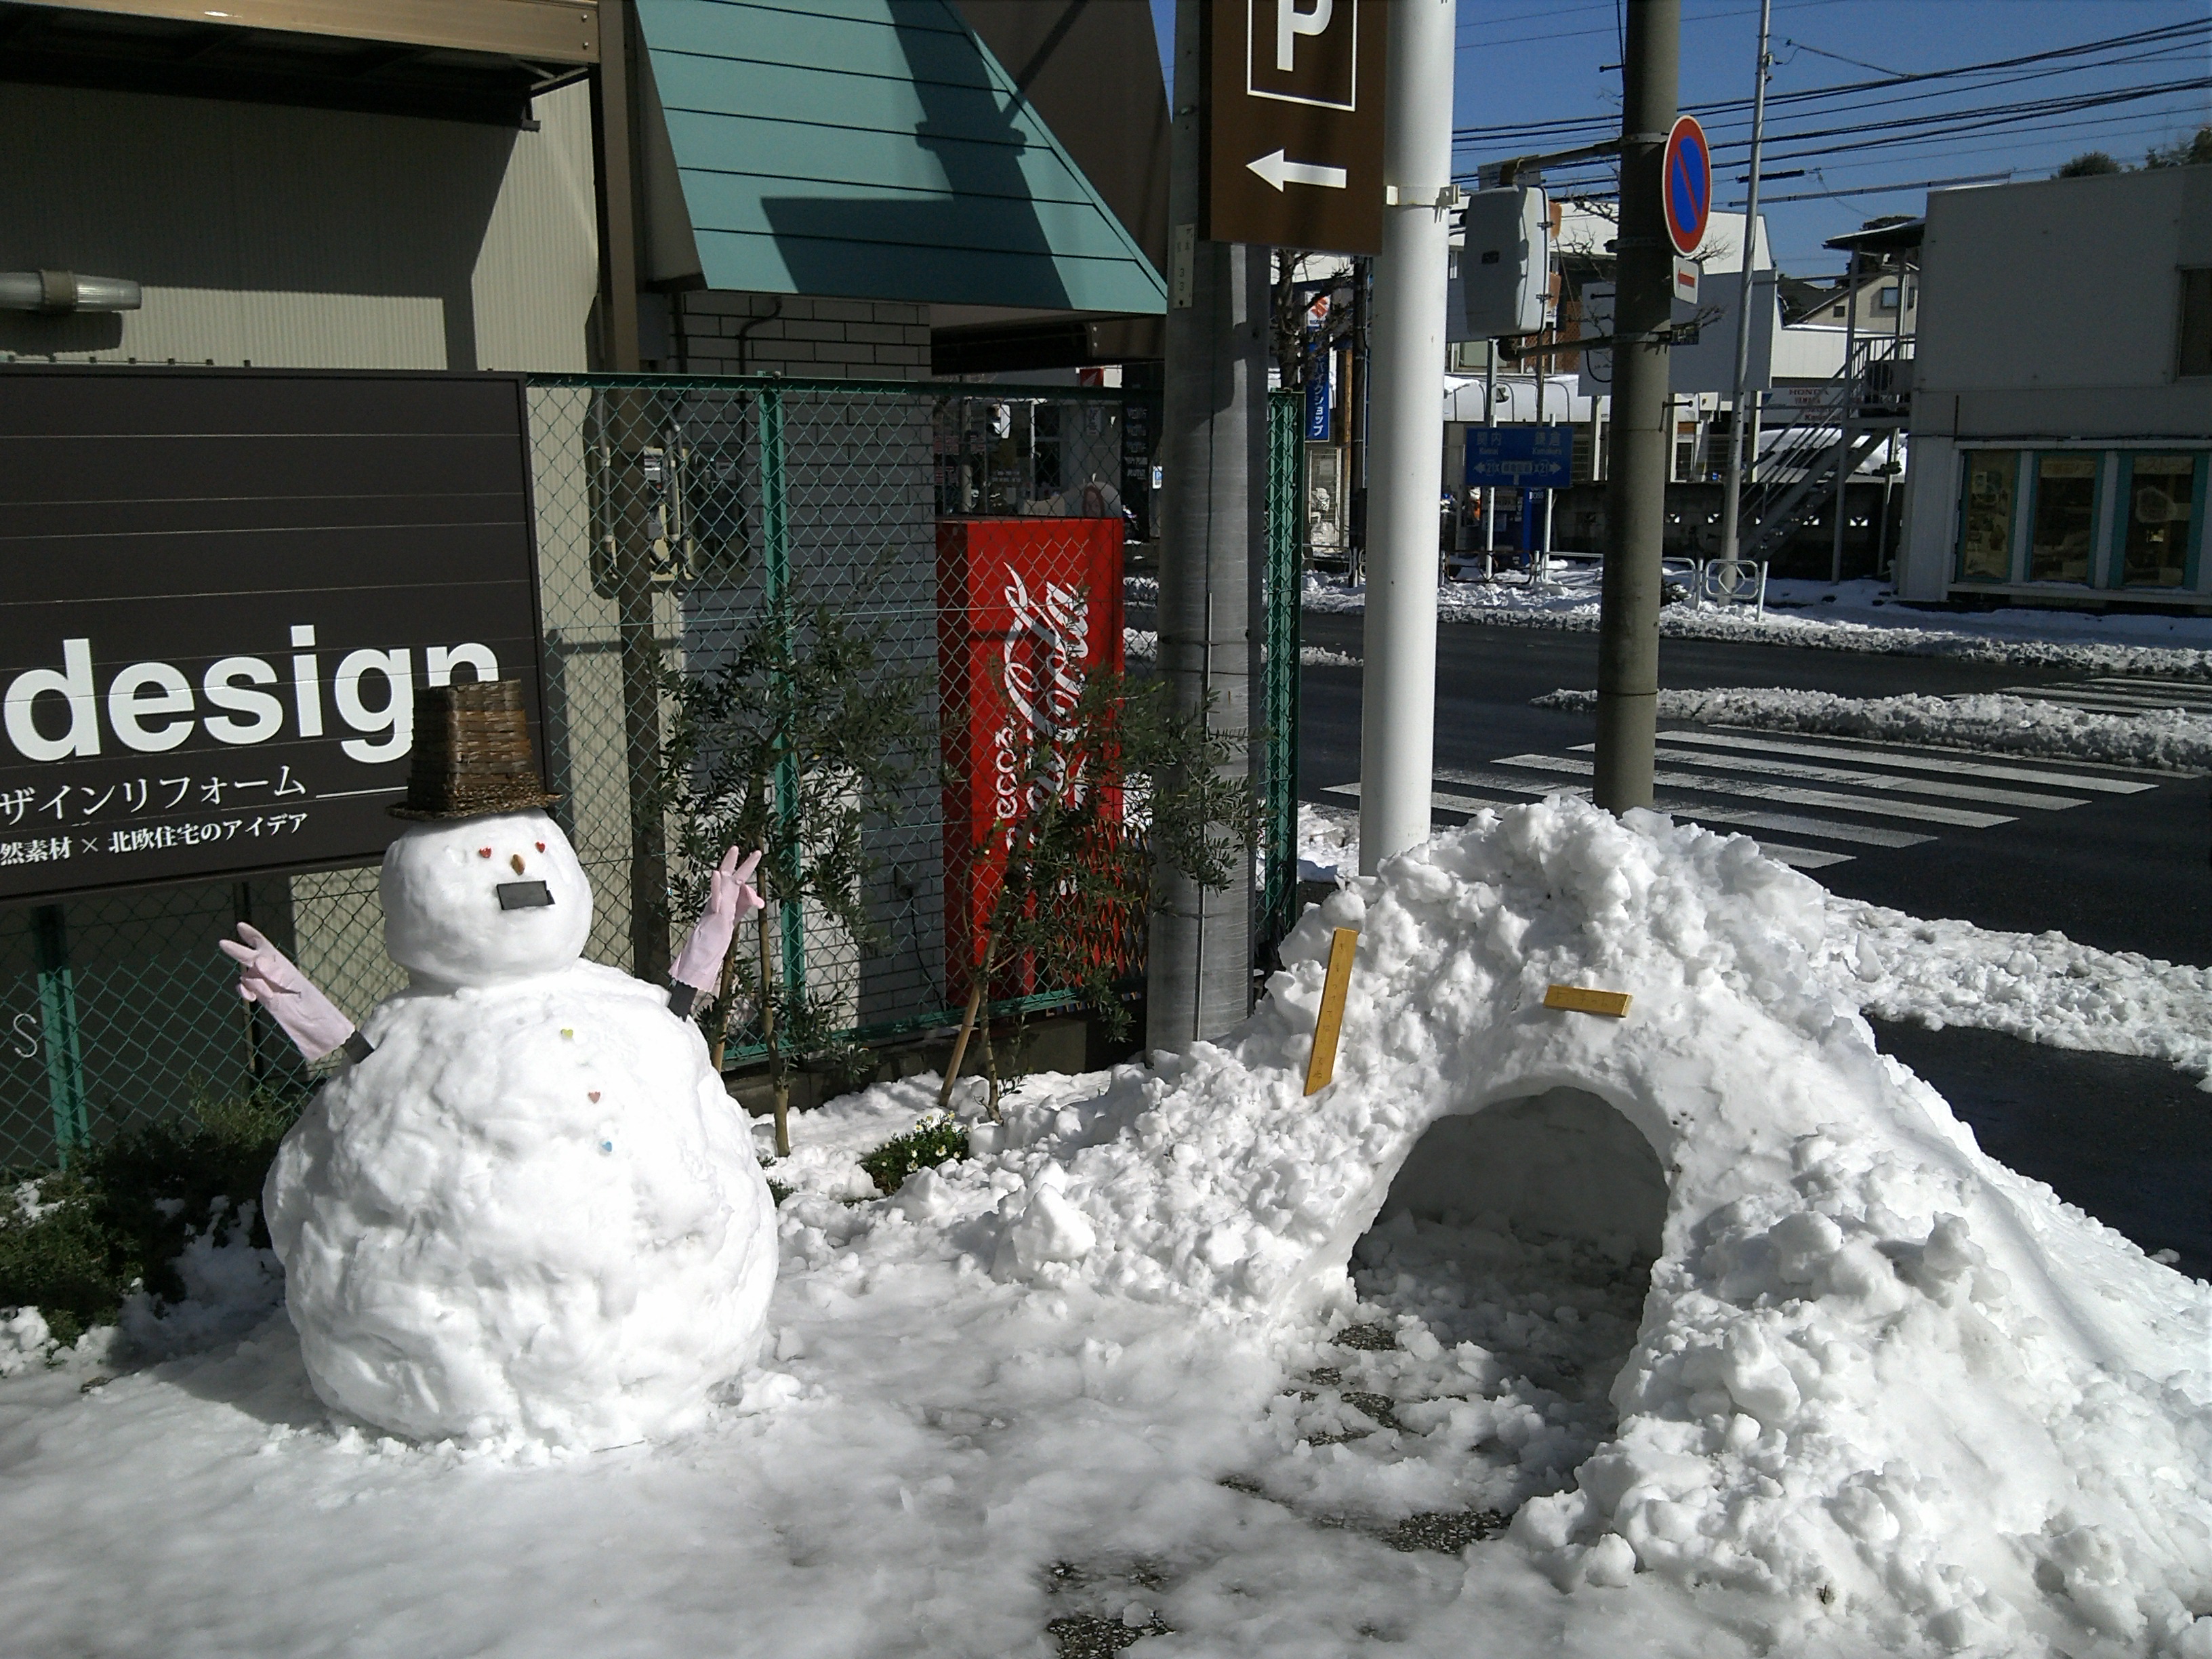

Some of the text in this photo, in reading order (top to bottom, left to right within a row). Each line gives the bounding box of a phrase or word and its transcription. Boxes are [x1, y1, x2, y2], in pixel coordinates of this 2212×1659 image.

[1277, 0, 1332, 72] P
[3, 624, 499, 763] design
[0, 765, 306, 825] ザインリフォーム
[108, 813, 308, 854] 北欧住宅のアイデア
